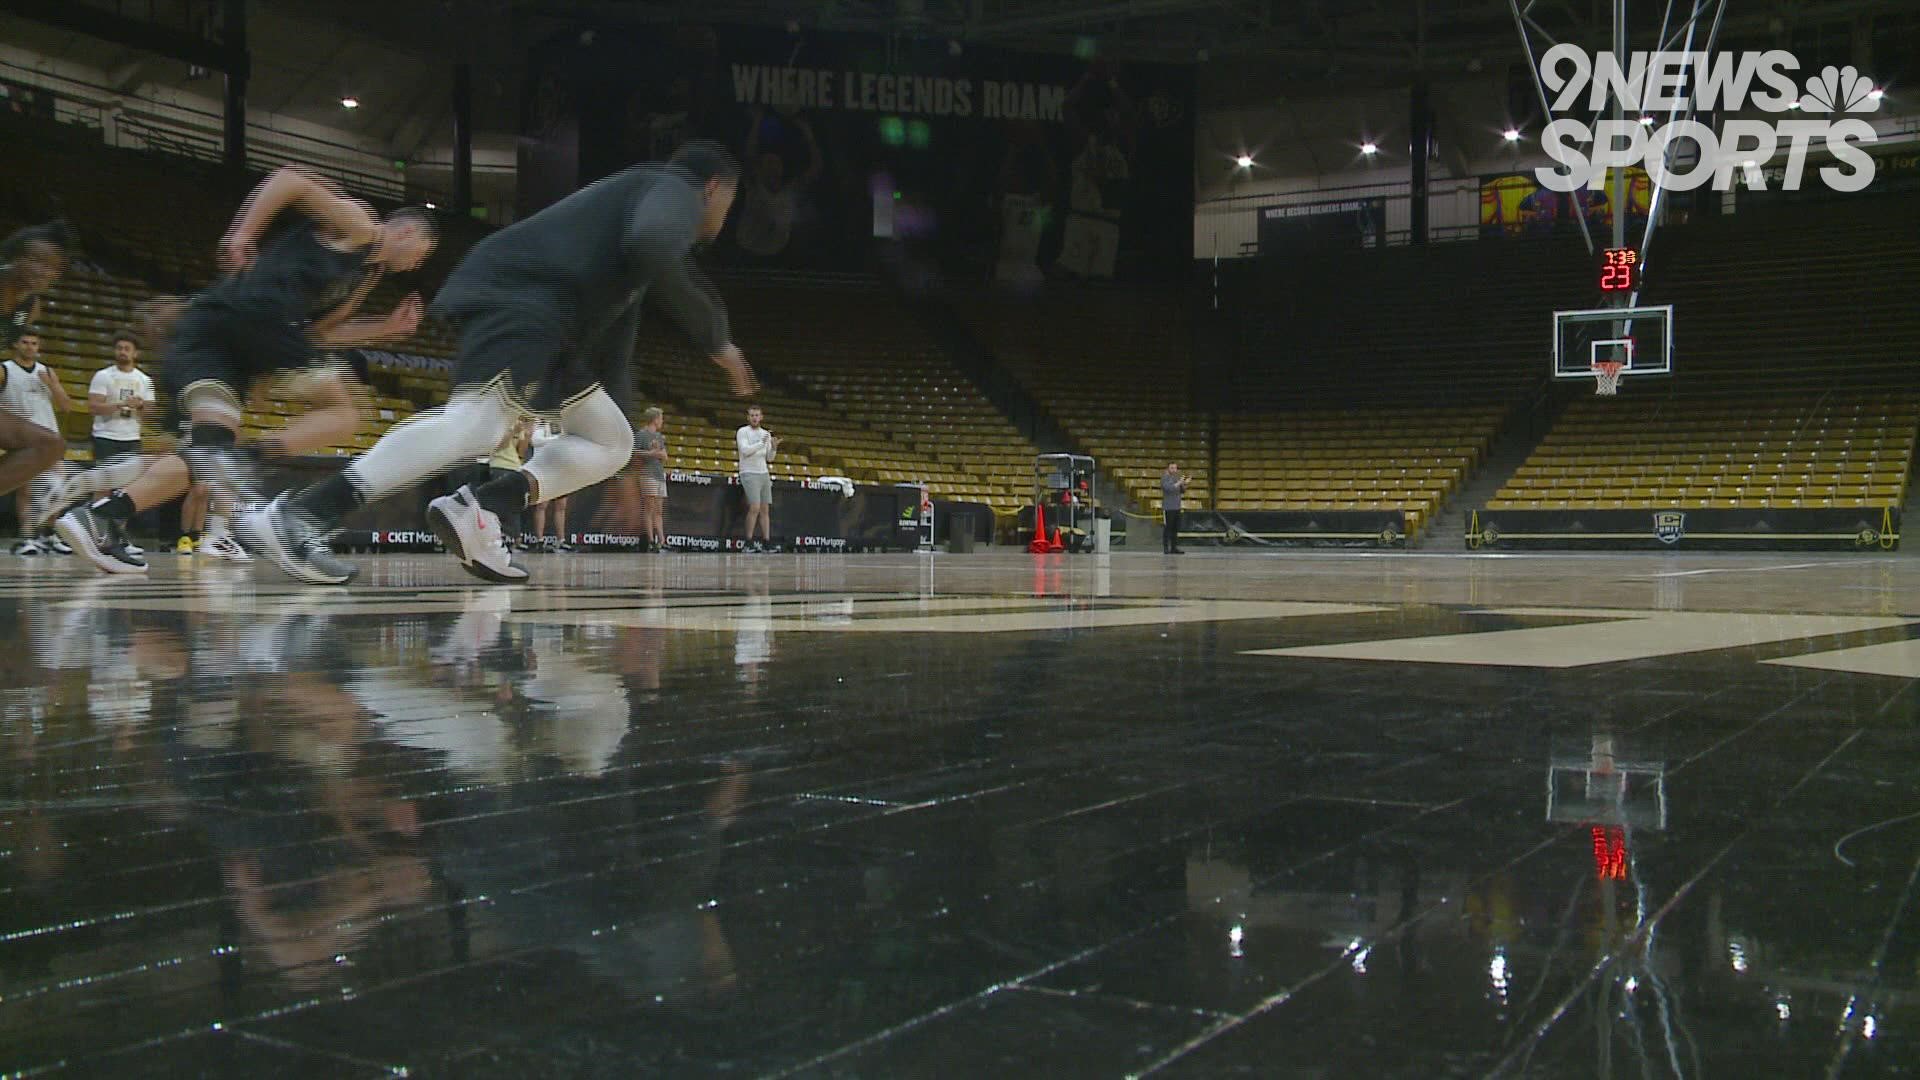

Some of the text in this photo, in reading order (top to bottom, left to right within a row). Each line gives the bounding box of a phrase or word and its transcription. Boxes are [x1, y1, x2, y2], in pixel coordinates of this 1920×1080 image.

[731, 63, 833, 106] WHERE
[845, 71, 972, 116] LEGENDS
[1265, 208, 1286, 218] WHERE
[1601, 265, 1631, 289] 23
[371, 531, 415, 544] ROCKET
[571, 533, 640, 546] ROCKET Mortgage
[687, 536, 720, 549] Mortgage
[796, 536, 846, 547] ROCKET Mortgage
